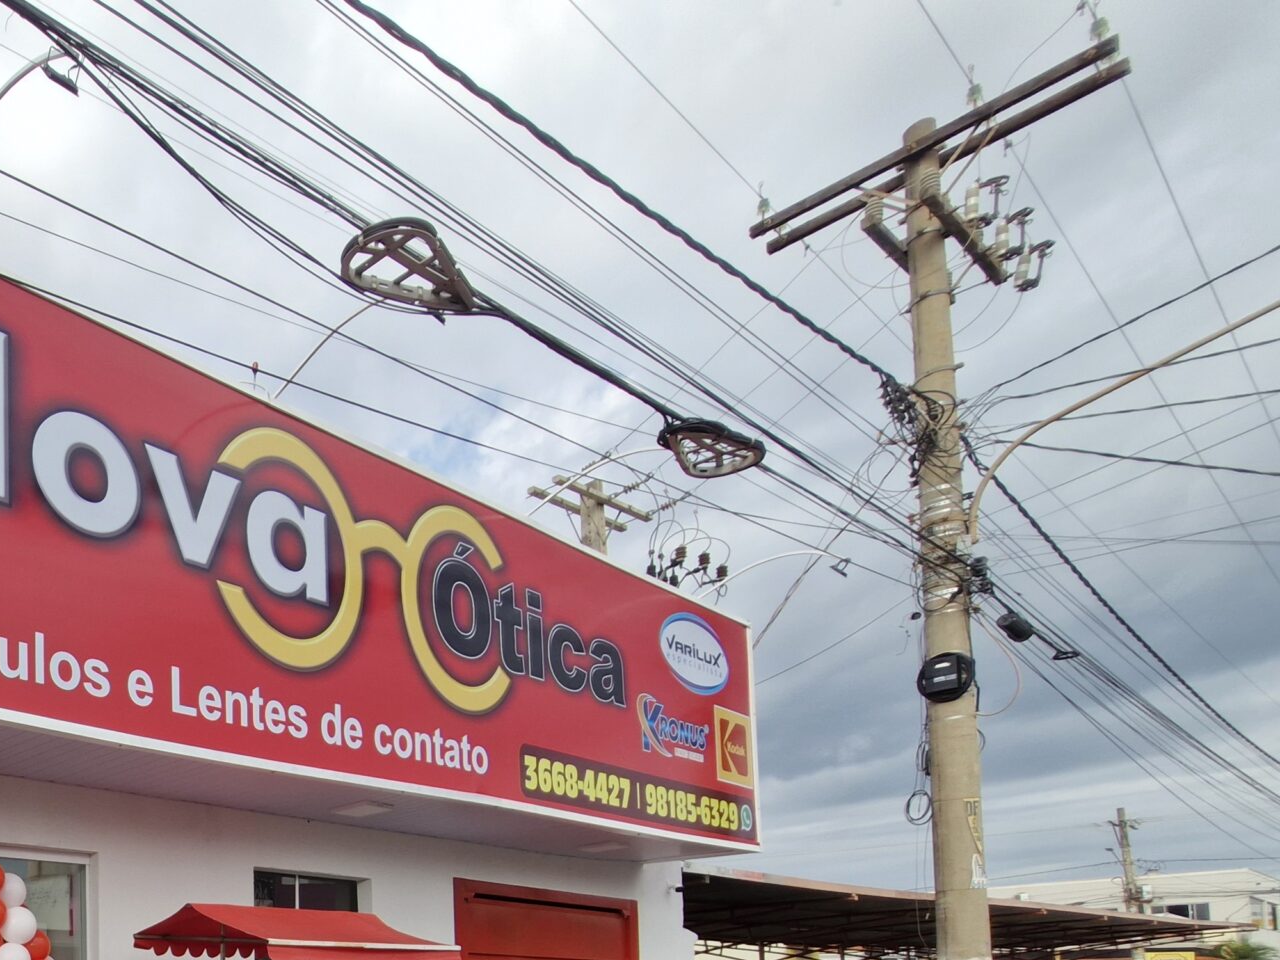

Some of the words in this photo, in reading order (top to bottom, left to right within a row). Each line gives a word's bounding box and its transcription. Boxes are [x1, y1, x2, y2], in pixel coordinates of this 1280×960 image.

[433, 541, 626, 708] Ótica
[127, 669, 154, 707] e
[171, 666, 308, 739] Lentes
[321, 704, 362, 750] de
[374, 723, 489, 775] contato
[726, 741, 746, 757] Kodak
[524, 755, 630, 808] 3668-4427
[645, 784, 739, 831] 98185-6329
